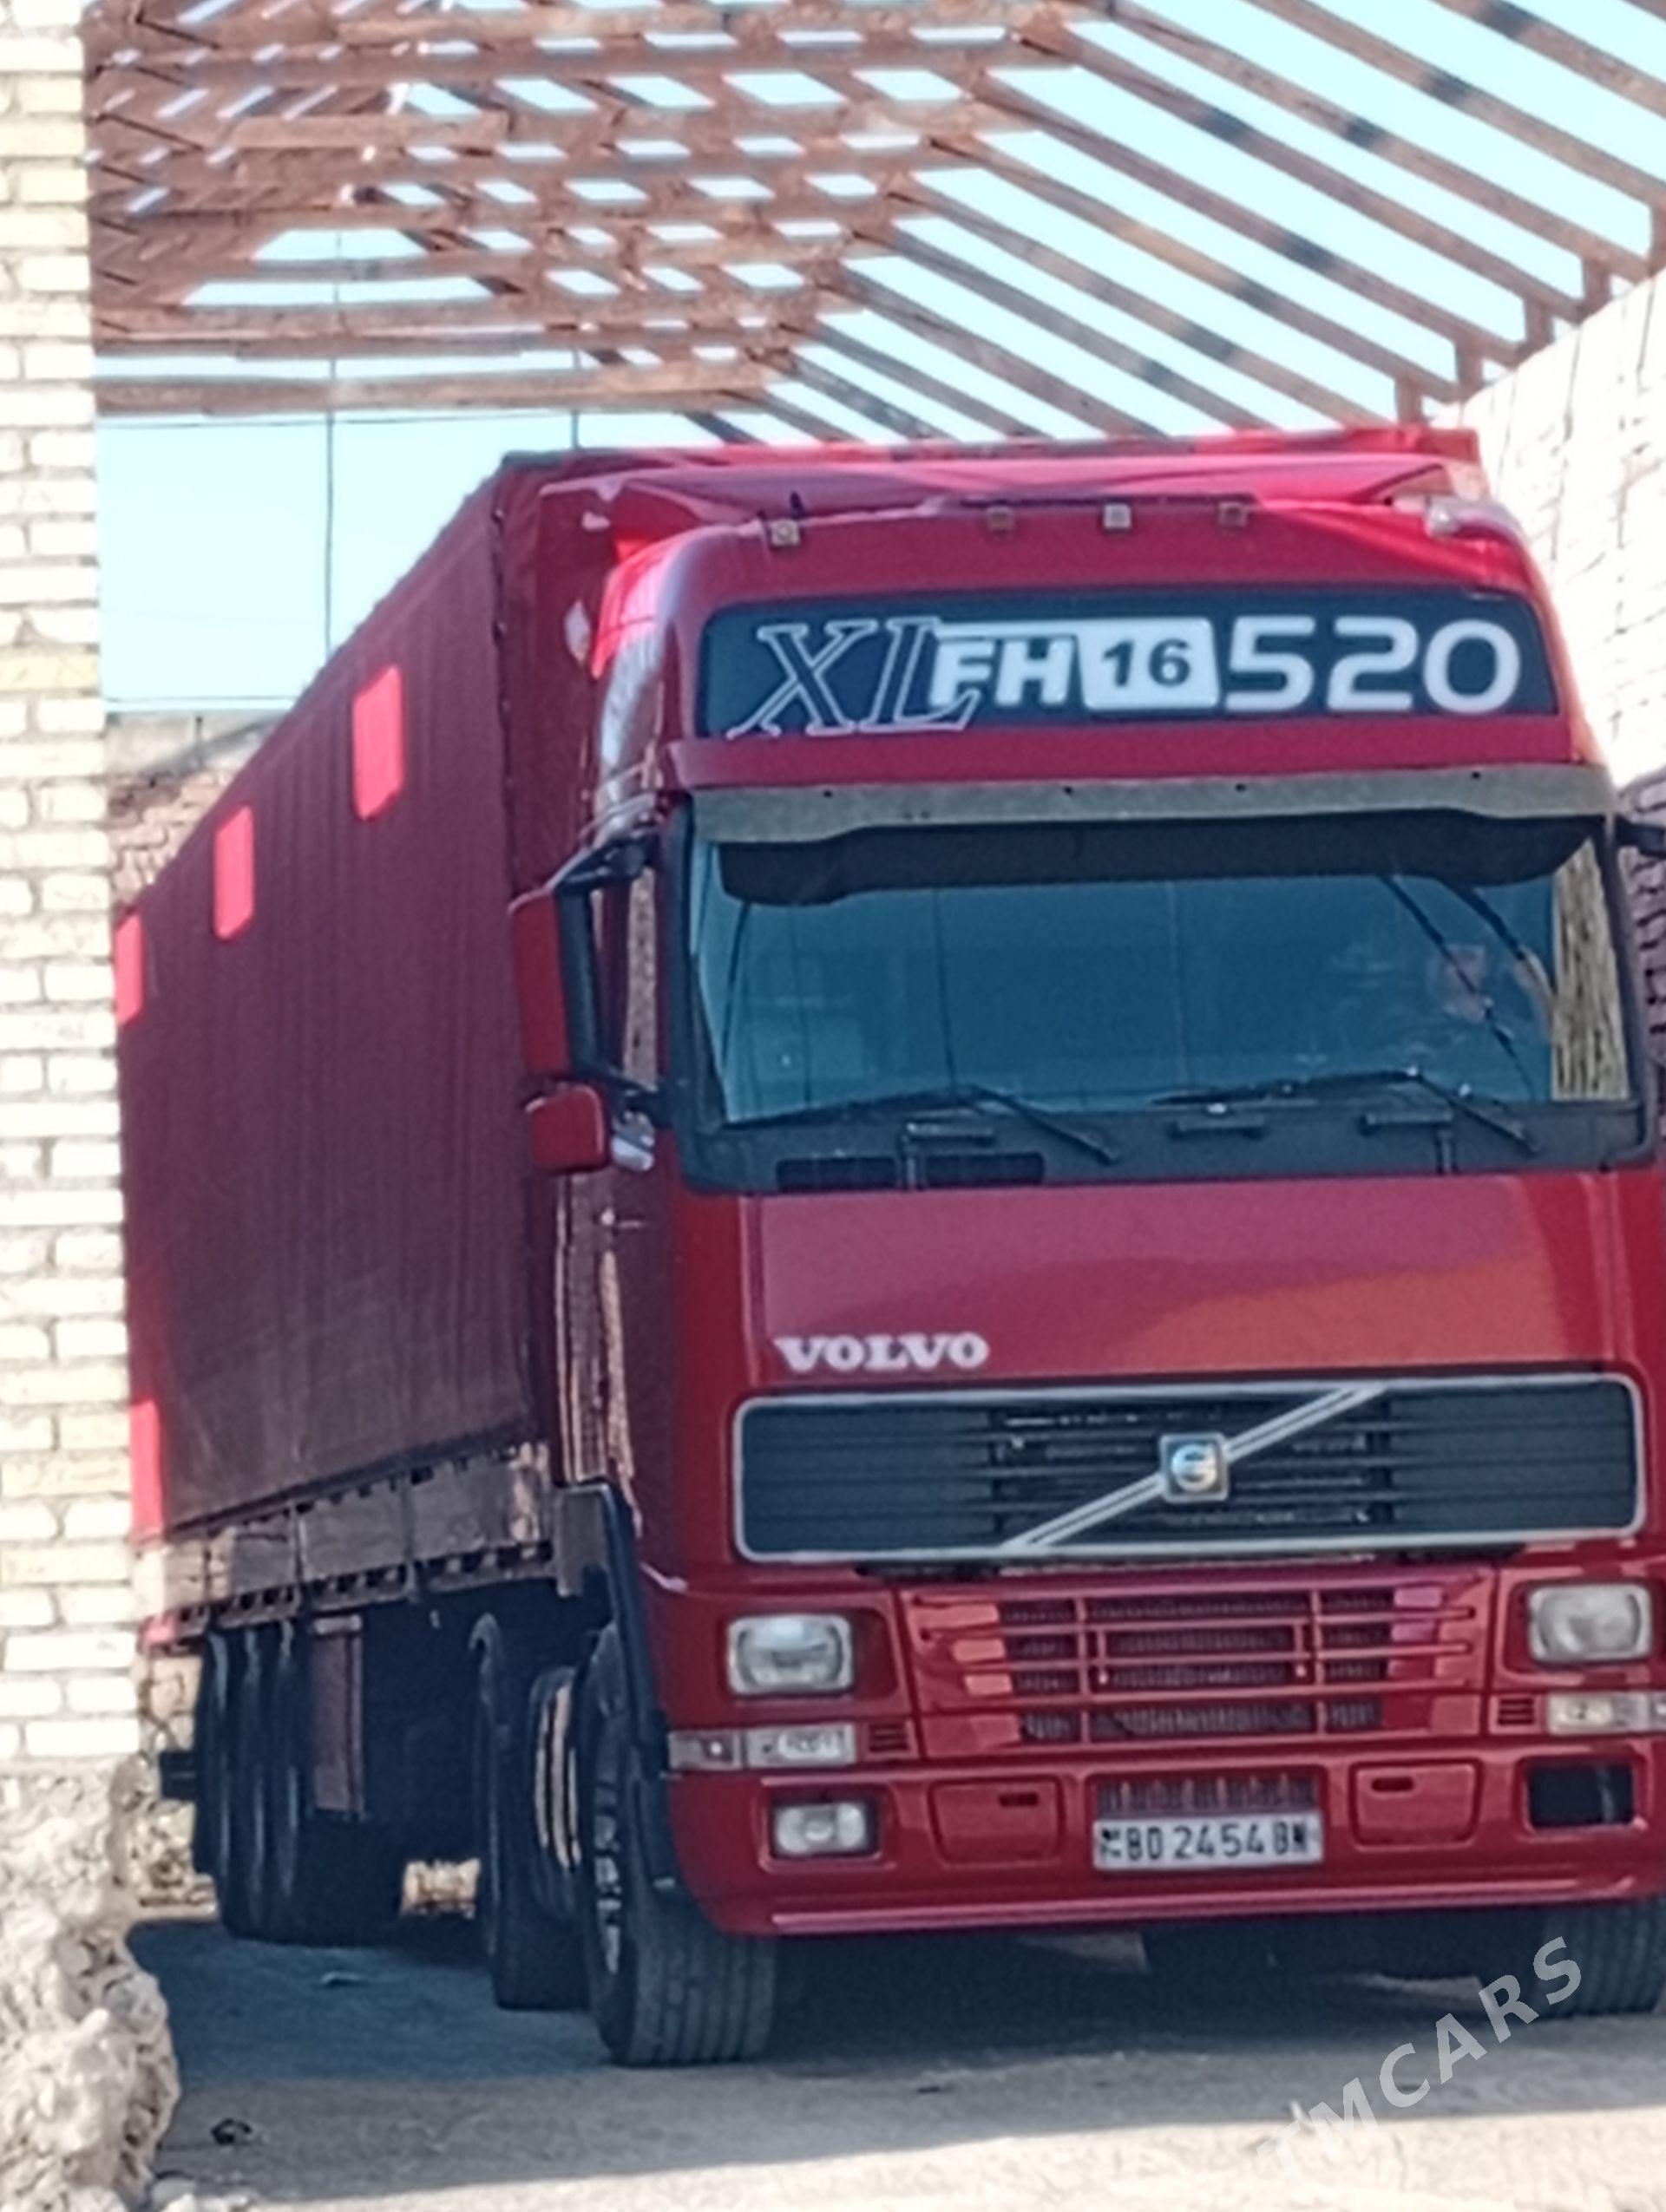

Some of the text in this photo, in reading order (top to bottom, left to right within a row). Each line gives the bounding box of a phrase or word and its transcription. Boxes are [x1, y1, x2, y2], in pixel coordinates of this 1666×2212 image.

[726, 616, 1521, 739] XL FH 16 520
[772, 1332, 990, 1372] VOLVO
[1172, 1823, 1264, 1859] 2454
